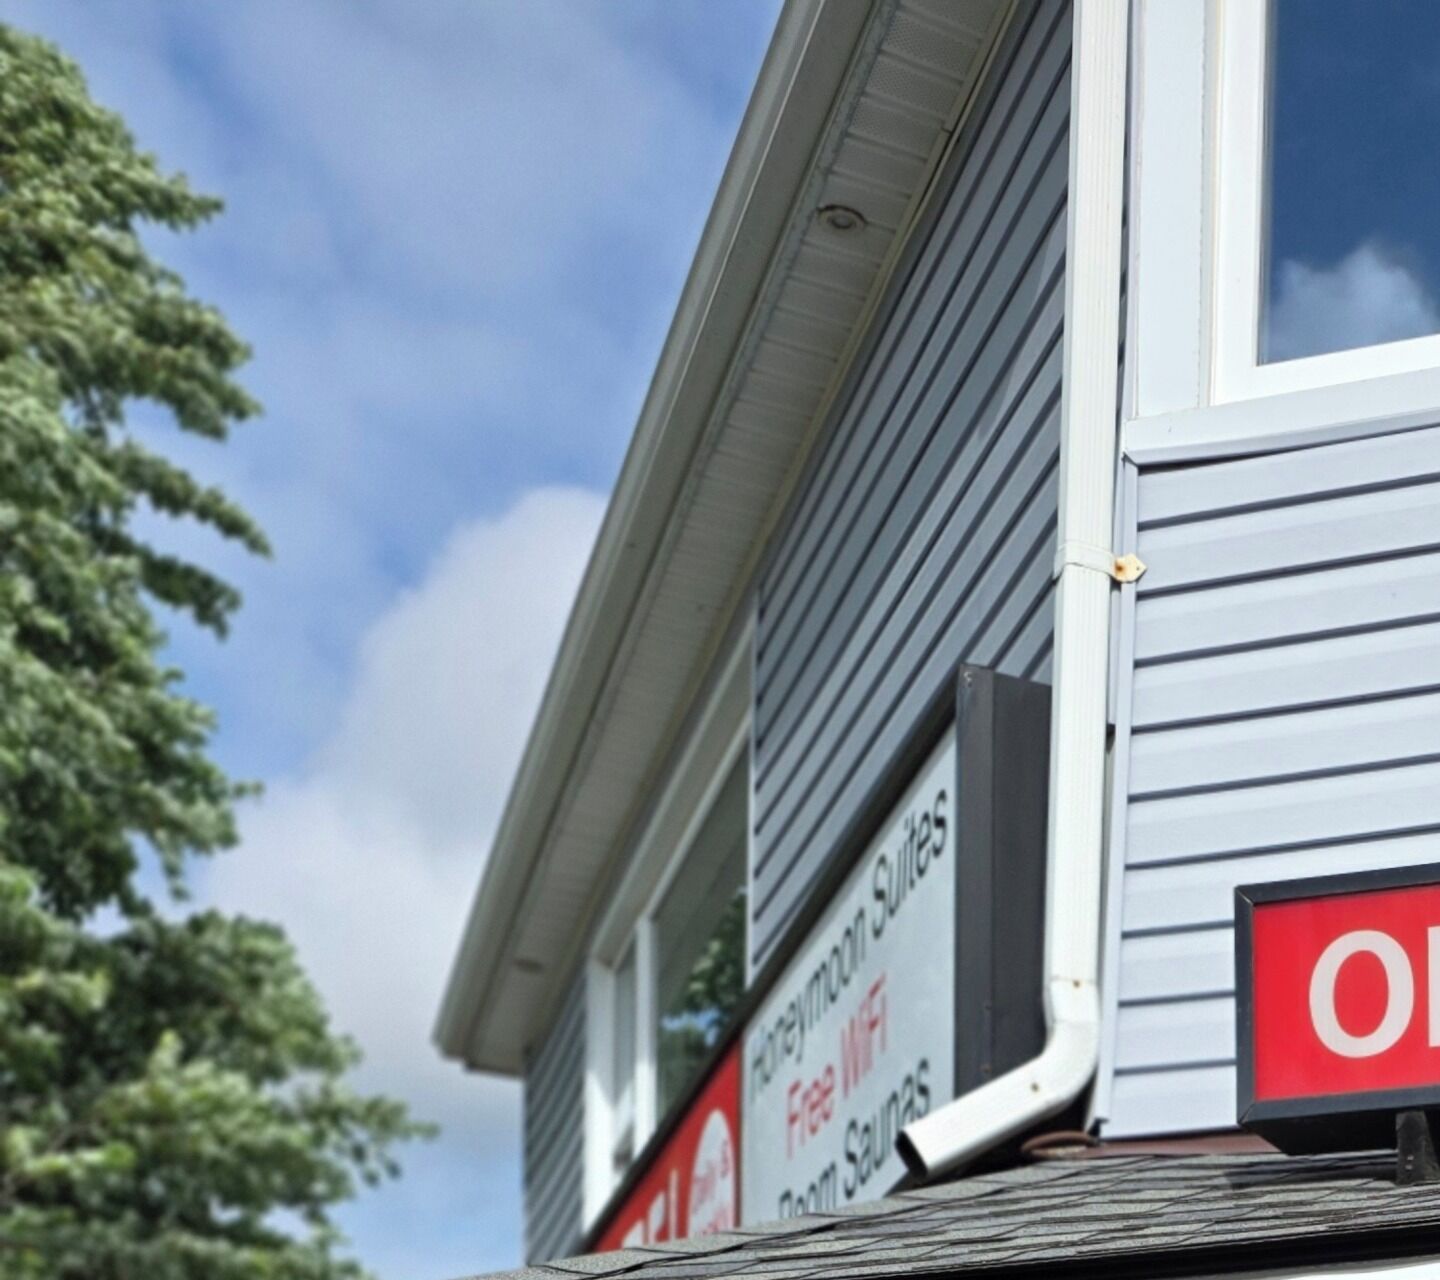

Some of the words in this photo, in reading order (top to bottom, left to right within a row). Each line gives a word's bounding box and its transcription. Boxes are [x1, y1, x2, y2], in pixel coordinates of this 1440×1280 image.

[750, 905, 867, 1106] Honeymoon
[871, 788, 948, 940] Suites
[786, 1064, 836, 1160] Free
[840, 971, 887, 1099] WiFi
[844, 1058, 930, 1200] Saunas
